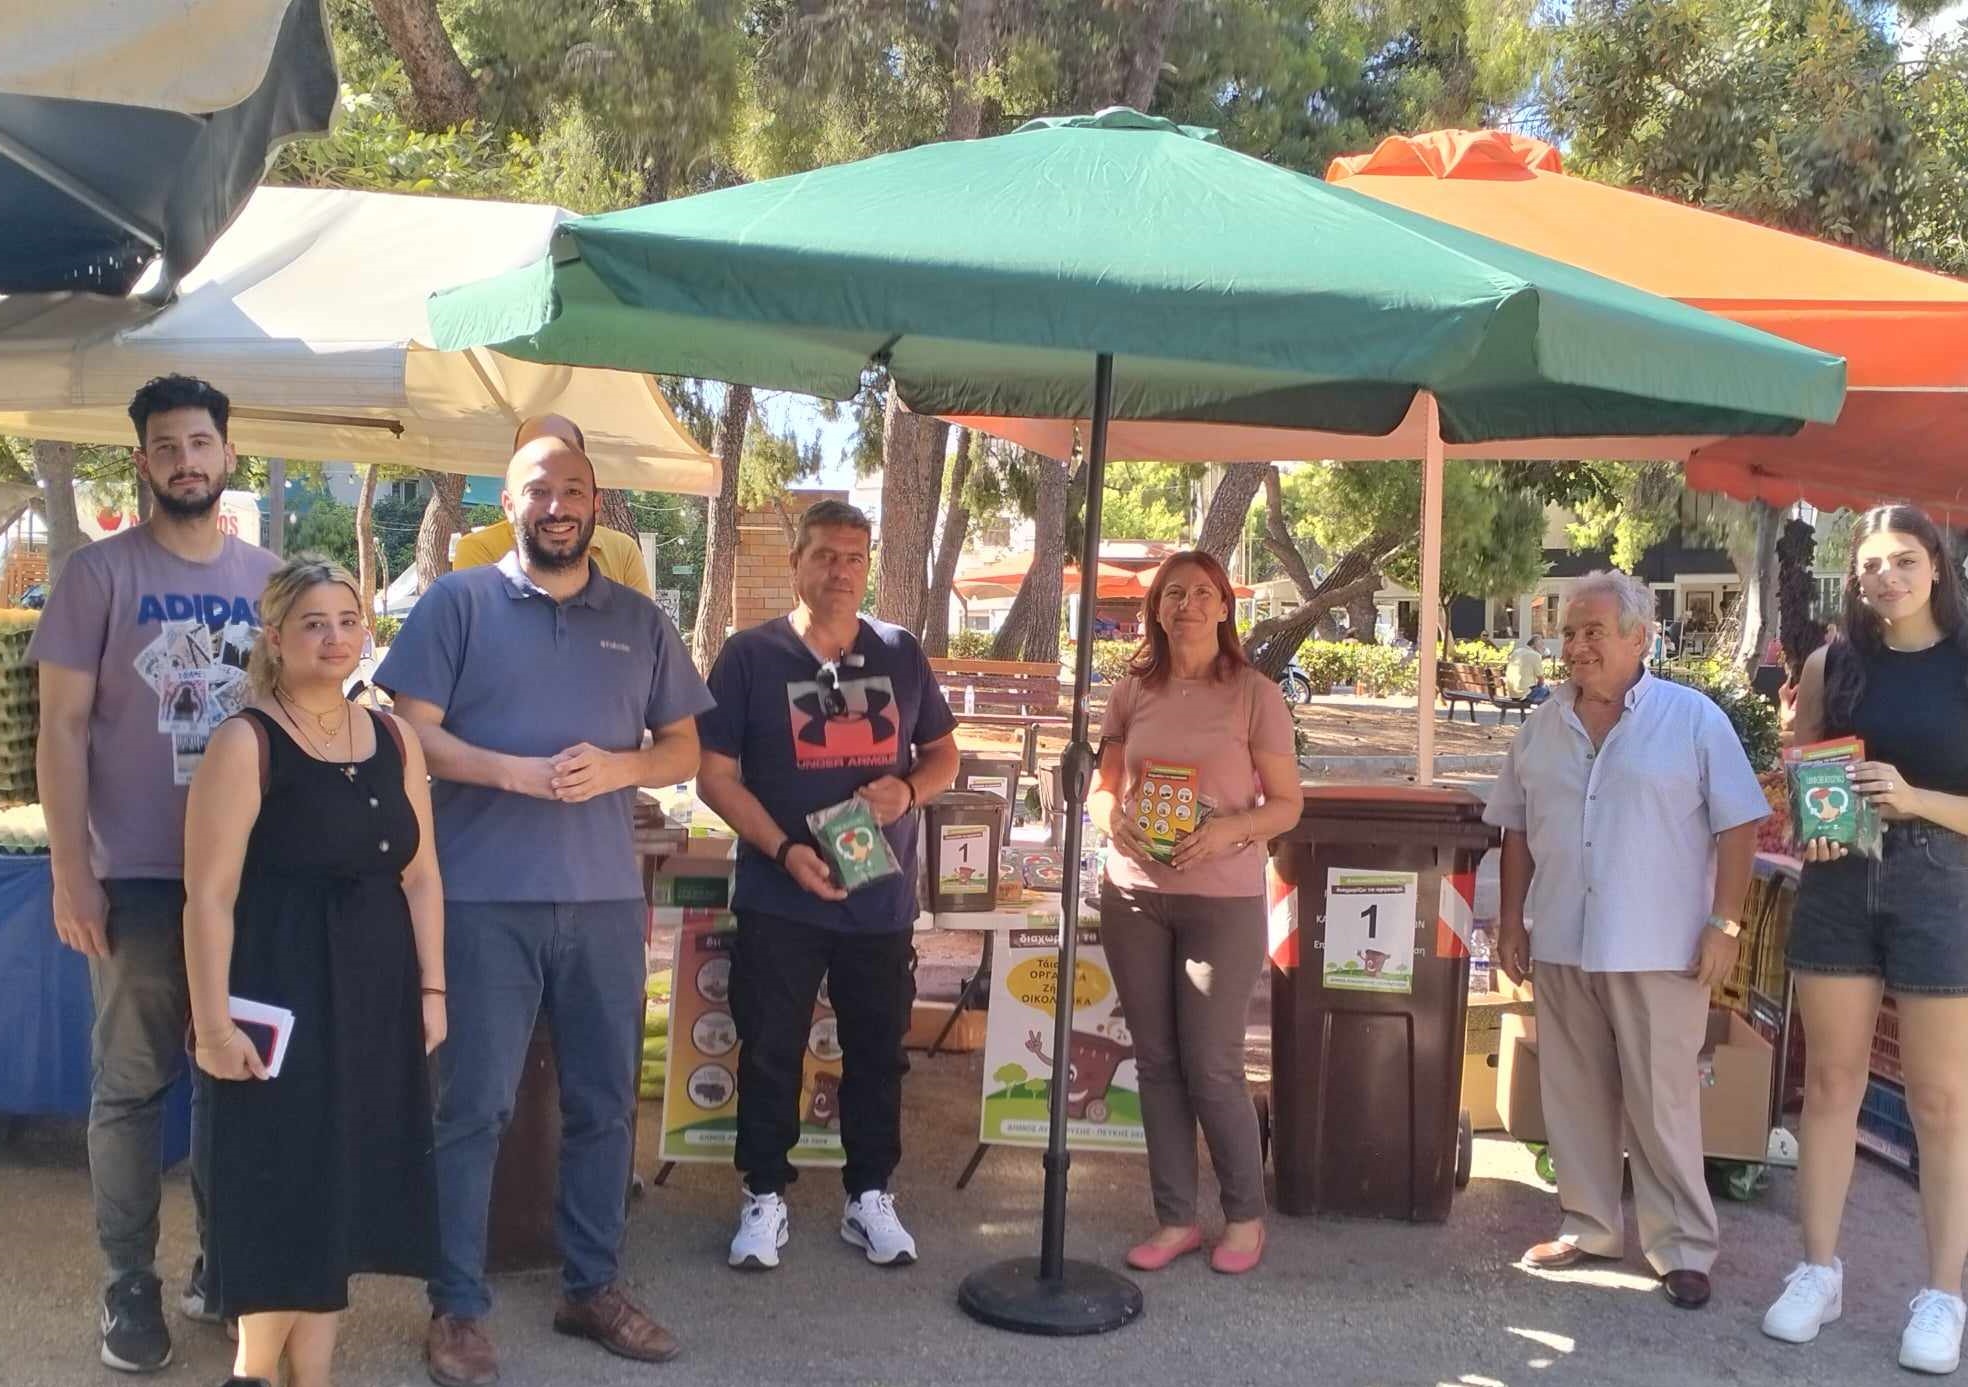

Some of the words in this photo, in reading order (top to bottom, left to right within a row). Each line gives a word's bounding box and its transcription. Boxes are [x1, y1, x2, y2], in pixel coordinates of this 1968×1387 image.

[138, 592, 262, 633] ADIDA
[797, 758, 844, 770] UNDER
[958, 843, 968, 863] 1
[1361, 904, 1378, 939] 1
